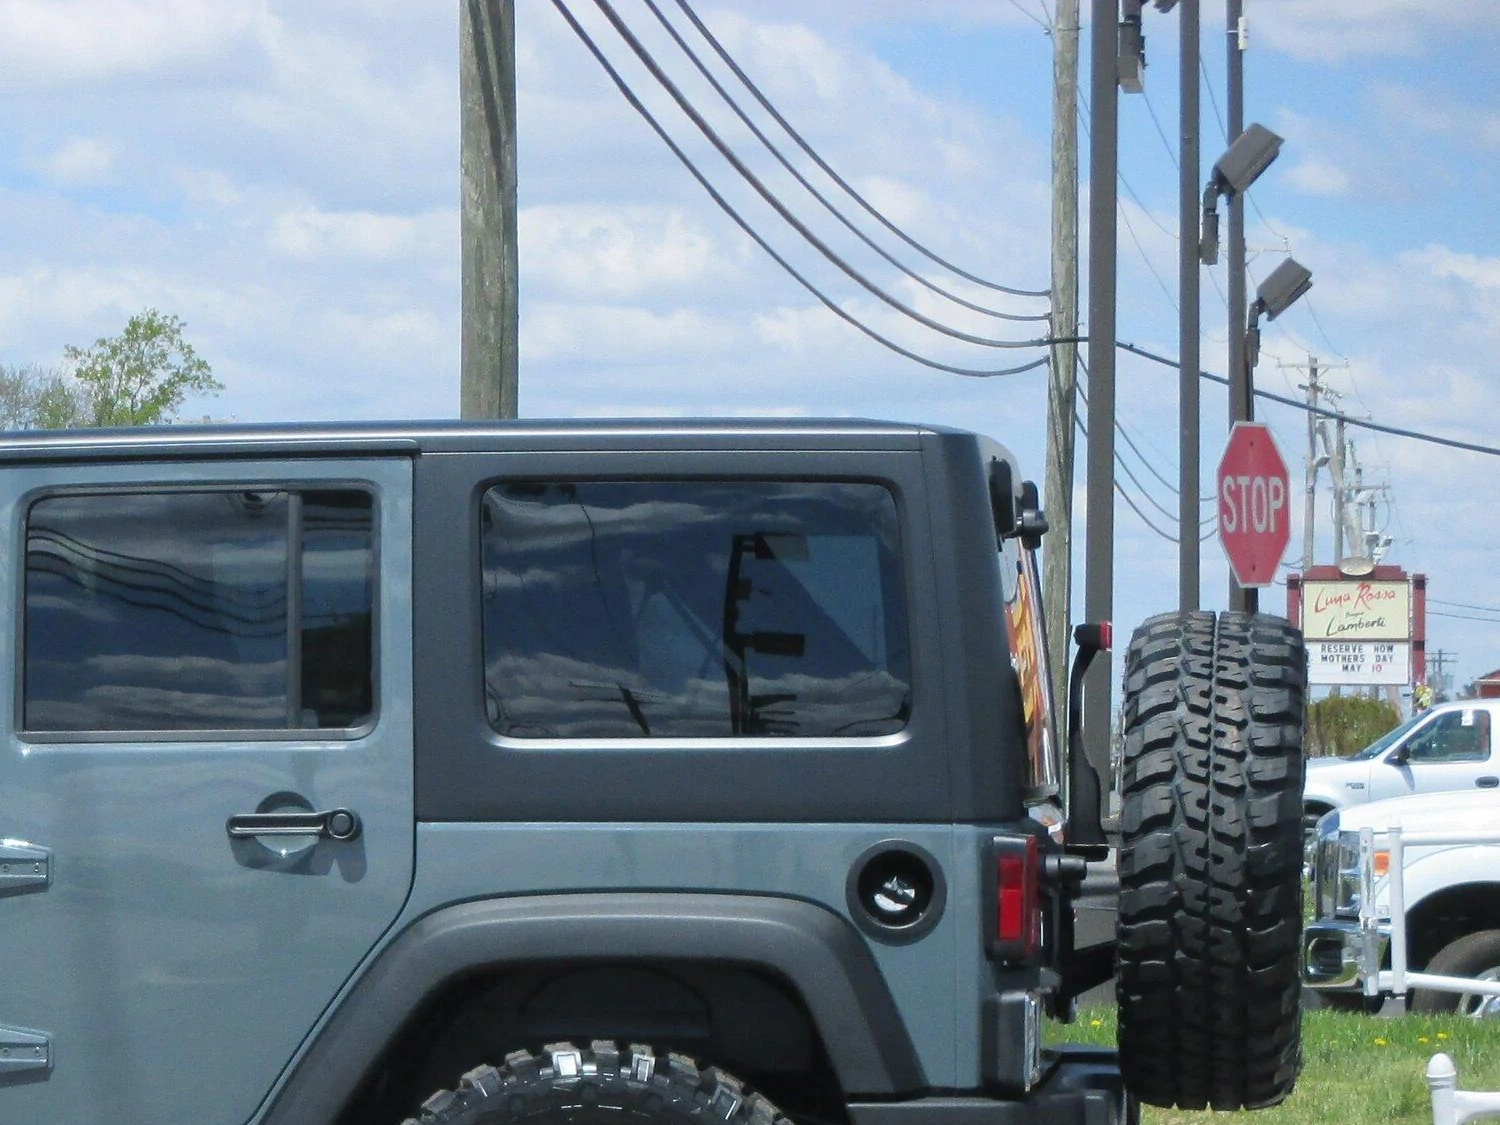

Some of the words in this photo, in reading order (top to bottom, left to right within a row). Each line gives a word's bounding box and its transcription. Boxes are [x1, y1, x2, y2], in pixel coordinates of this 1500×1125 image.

[1222, 475, 1284, 533] STOP
[1314, 586, 1350, 613] Luna
[1353, 582, 1395, 610] Rossa
[1326, 616, 1386, 636] Lamberti
[1321, 644, 1363, 653] RESERVE
[1373, 643, 1394, 653] NOW
[1321, 654, 1365, 663] MOTHERS
[1375, 654, 1393, 663] DAY
[1342, 664, 1361, 673] MAY
[1372, 664, 1382, 673] 10
